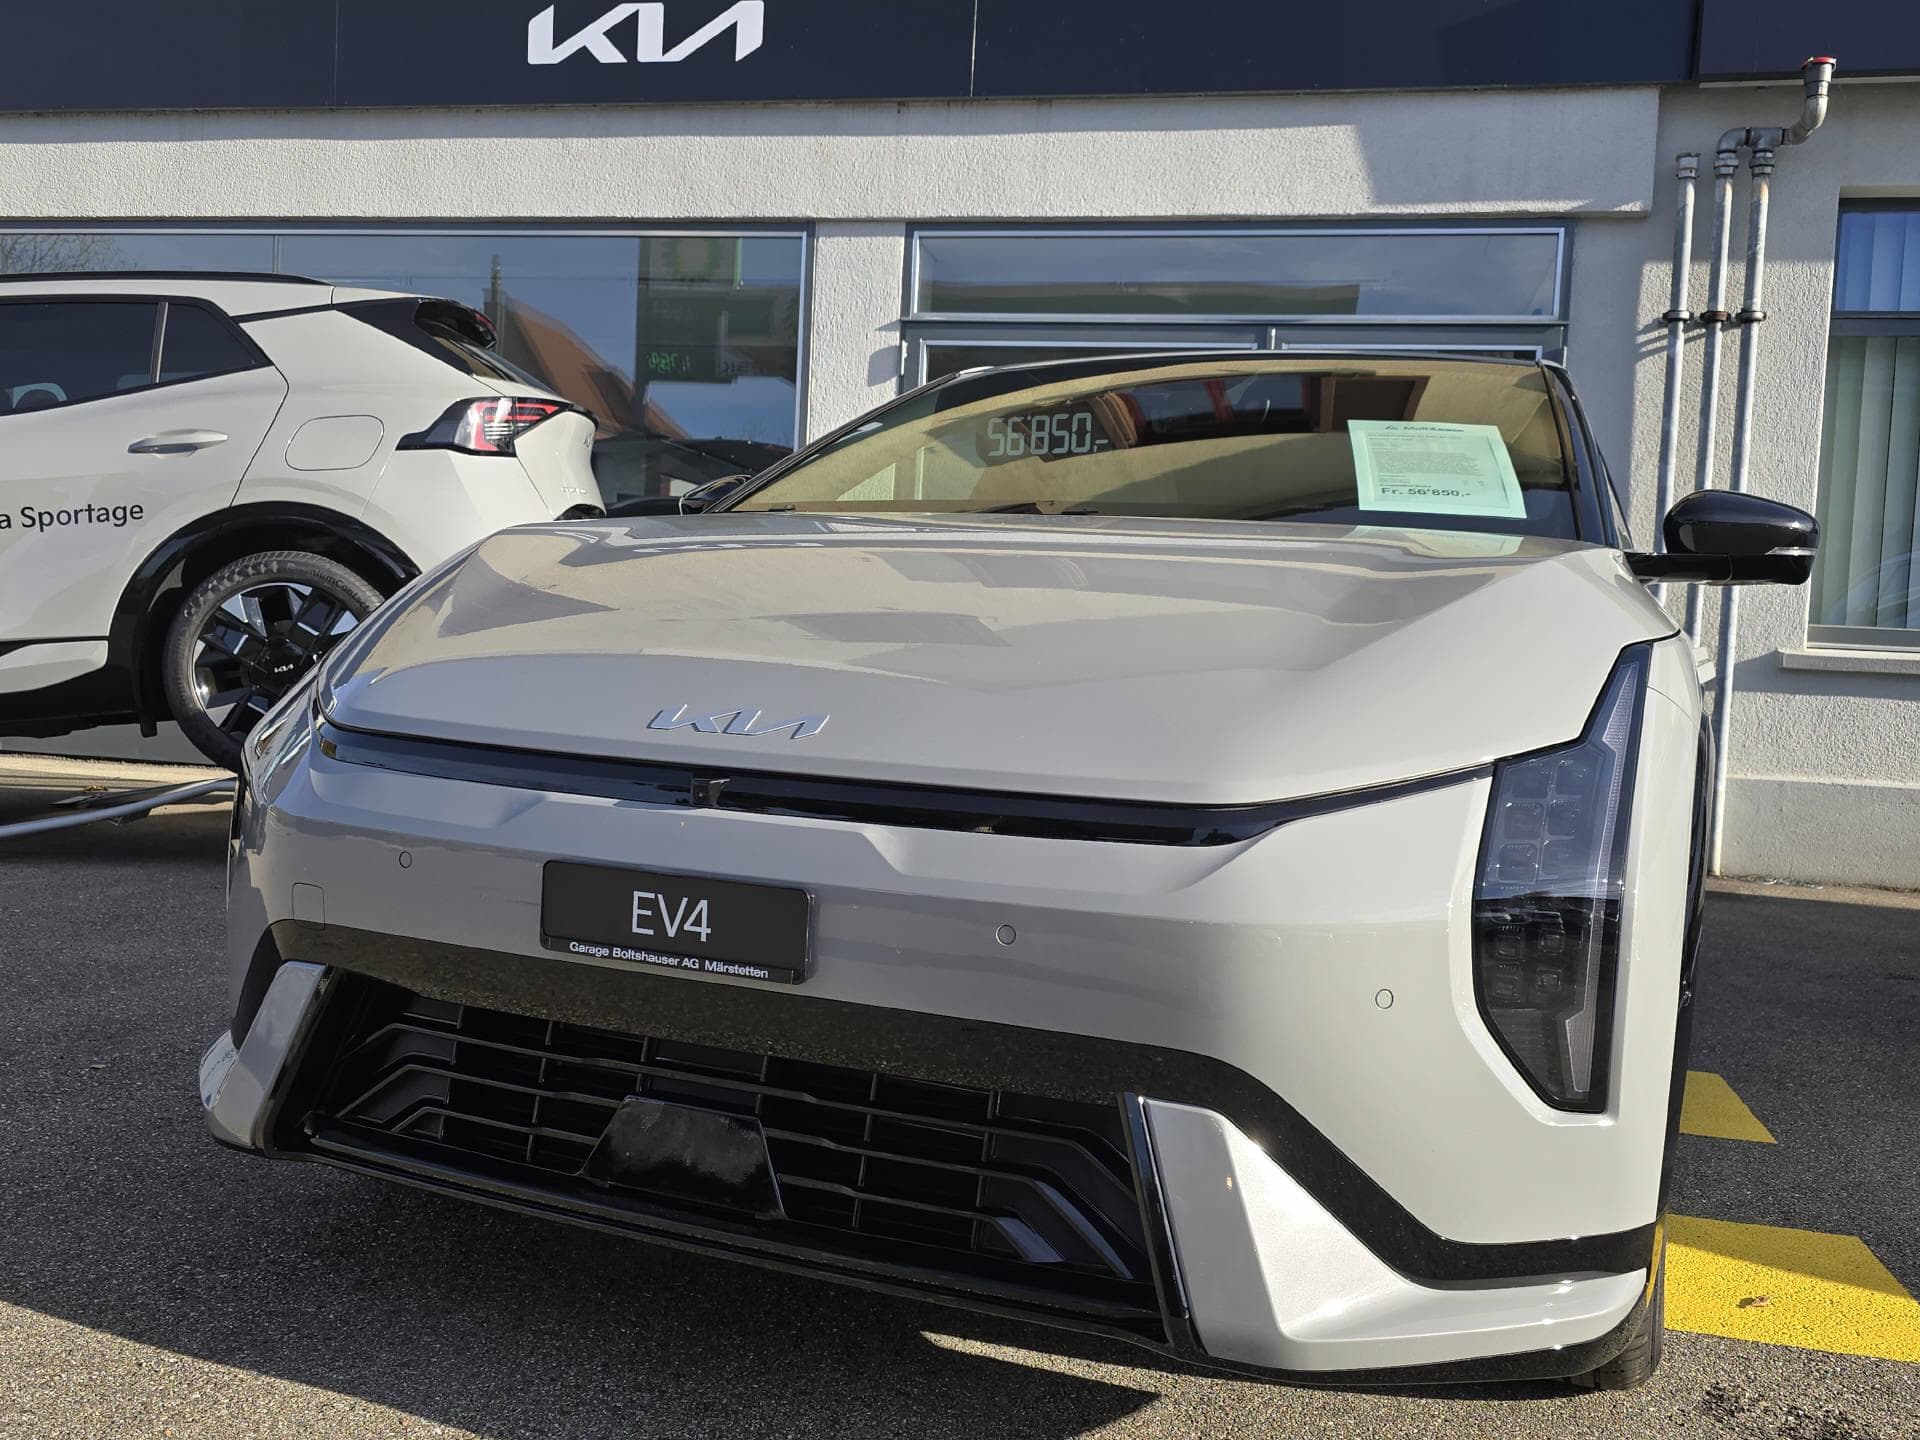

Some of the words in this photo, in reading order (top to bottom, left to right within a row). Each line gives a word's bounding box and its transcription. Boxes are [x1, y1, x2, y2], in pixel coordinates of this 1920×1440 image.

[528, 0, 765, 64] KIA
[1381, 486, 1403, 495] Fr.
[20, 503, 144, 532] Sportage
[274, 663, 294, 673] KIA
[646, 703, 830, 740] KIA
[631, 890, 712, 942] EV4
[569, 941, 609, 957] Garage
[612, 947, 680, 966] Boltshauser
[681, 957, 699, 969] AG
[705, 960, 769, 979] Märstetten
